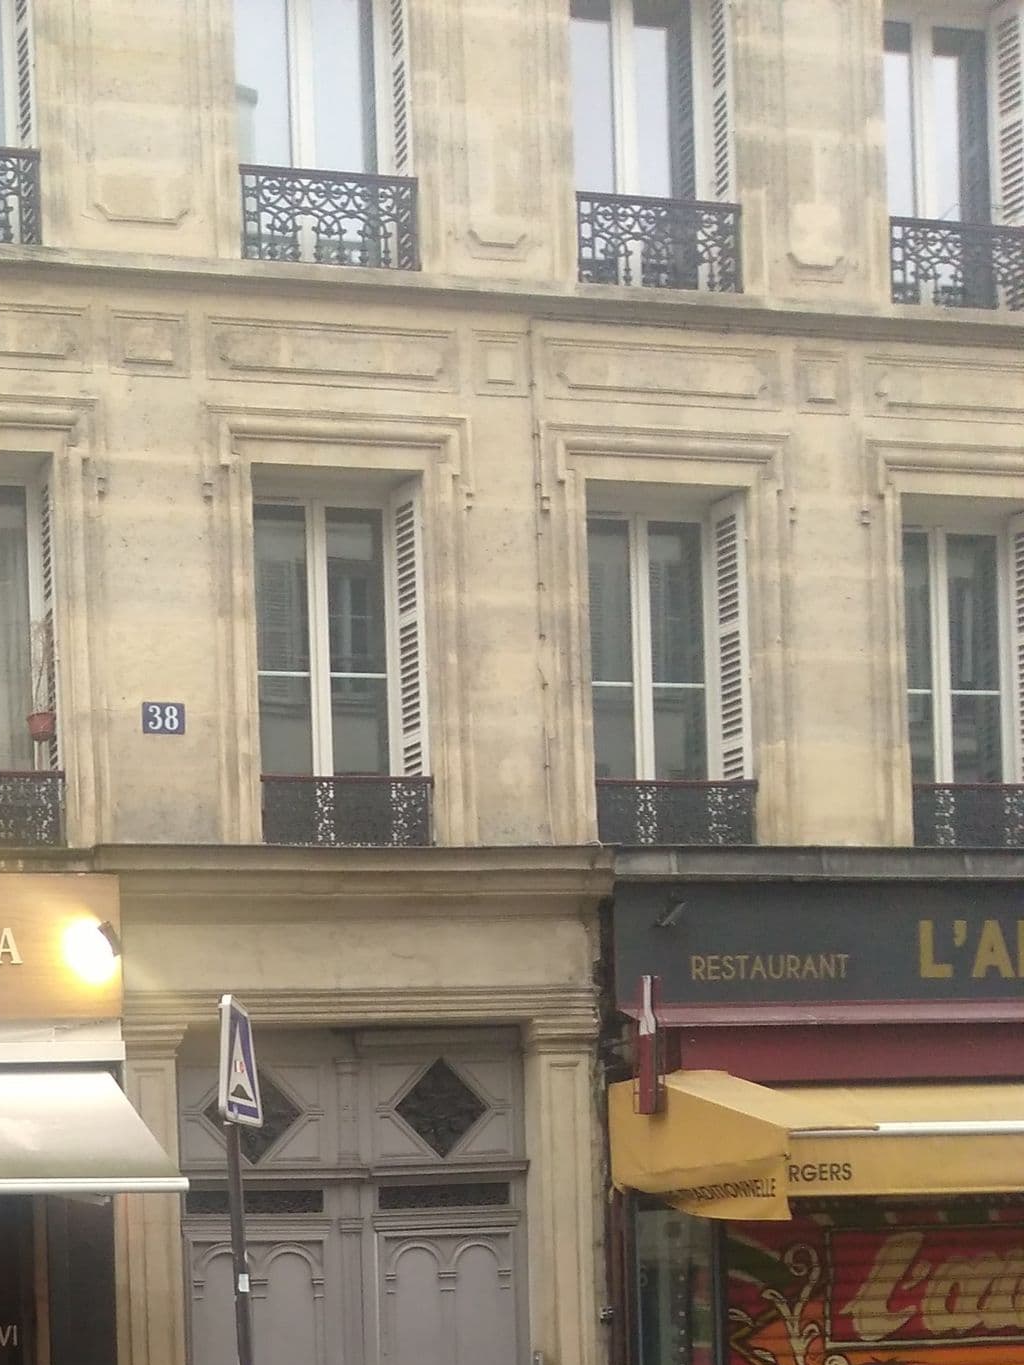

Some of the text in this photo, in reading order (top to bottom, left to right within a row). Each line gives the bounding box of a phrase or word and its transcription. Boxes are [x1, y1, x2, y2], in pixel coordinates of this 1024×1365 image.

[149, 705, 179, 730] 38
[919, 919, 1024, 978] L'A
[690, 954, 849, 981] RESTAURANT
[788, 1163, 852, 1182] RGERS
